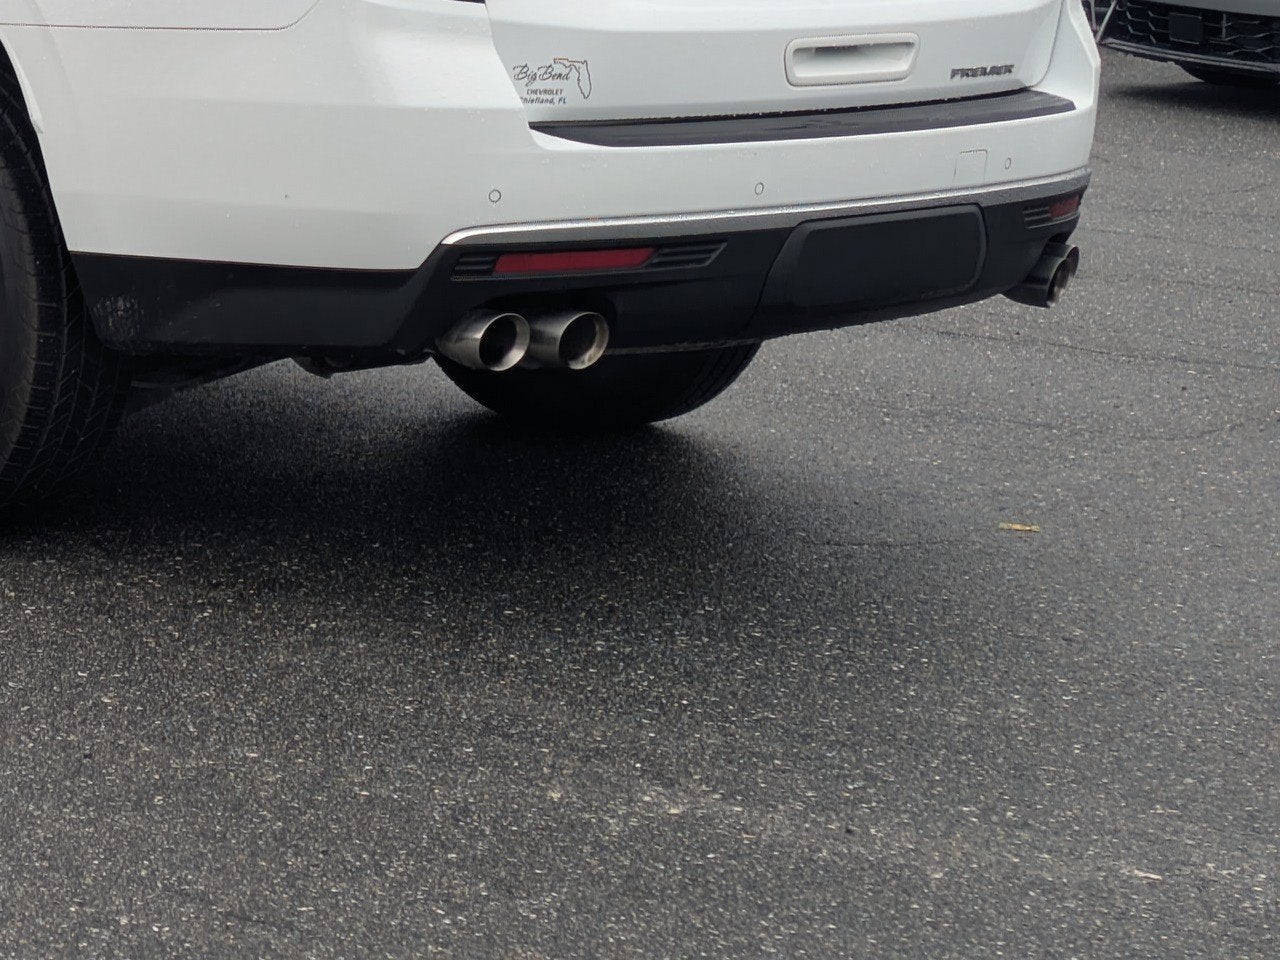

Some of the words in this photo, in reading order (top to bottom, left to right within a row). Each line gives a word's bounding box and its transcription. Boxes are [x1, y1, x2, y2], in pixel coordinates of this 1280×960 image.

[513, 63, 537, 87] Big
[537, 63, 573, 81] Bend
[949, 64, 1015, 80] PREMIER
[526, 88, 564, 96] CHEVROLET
[557, 97, 568, 105] FL
